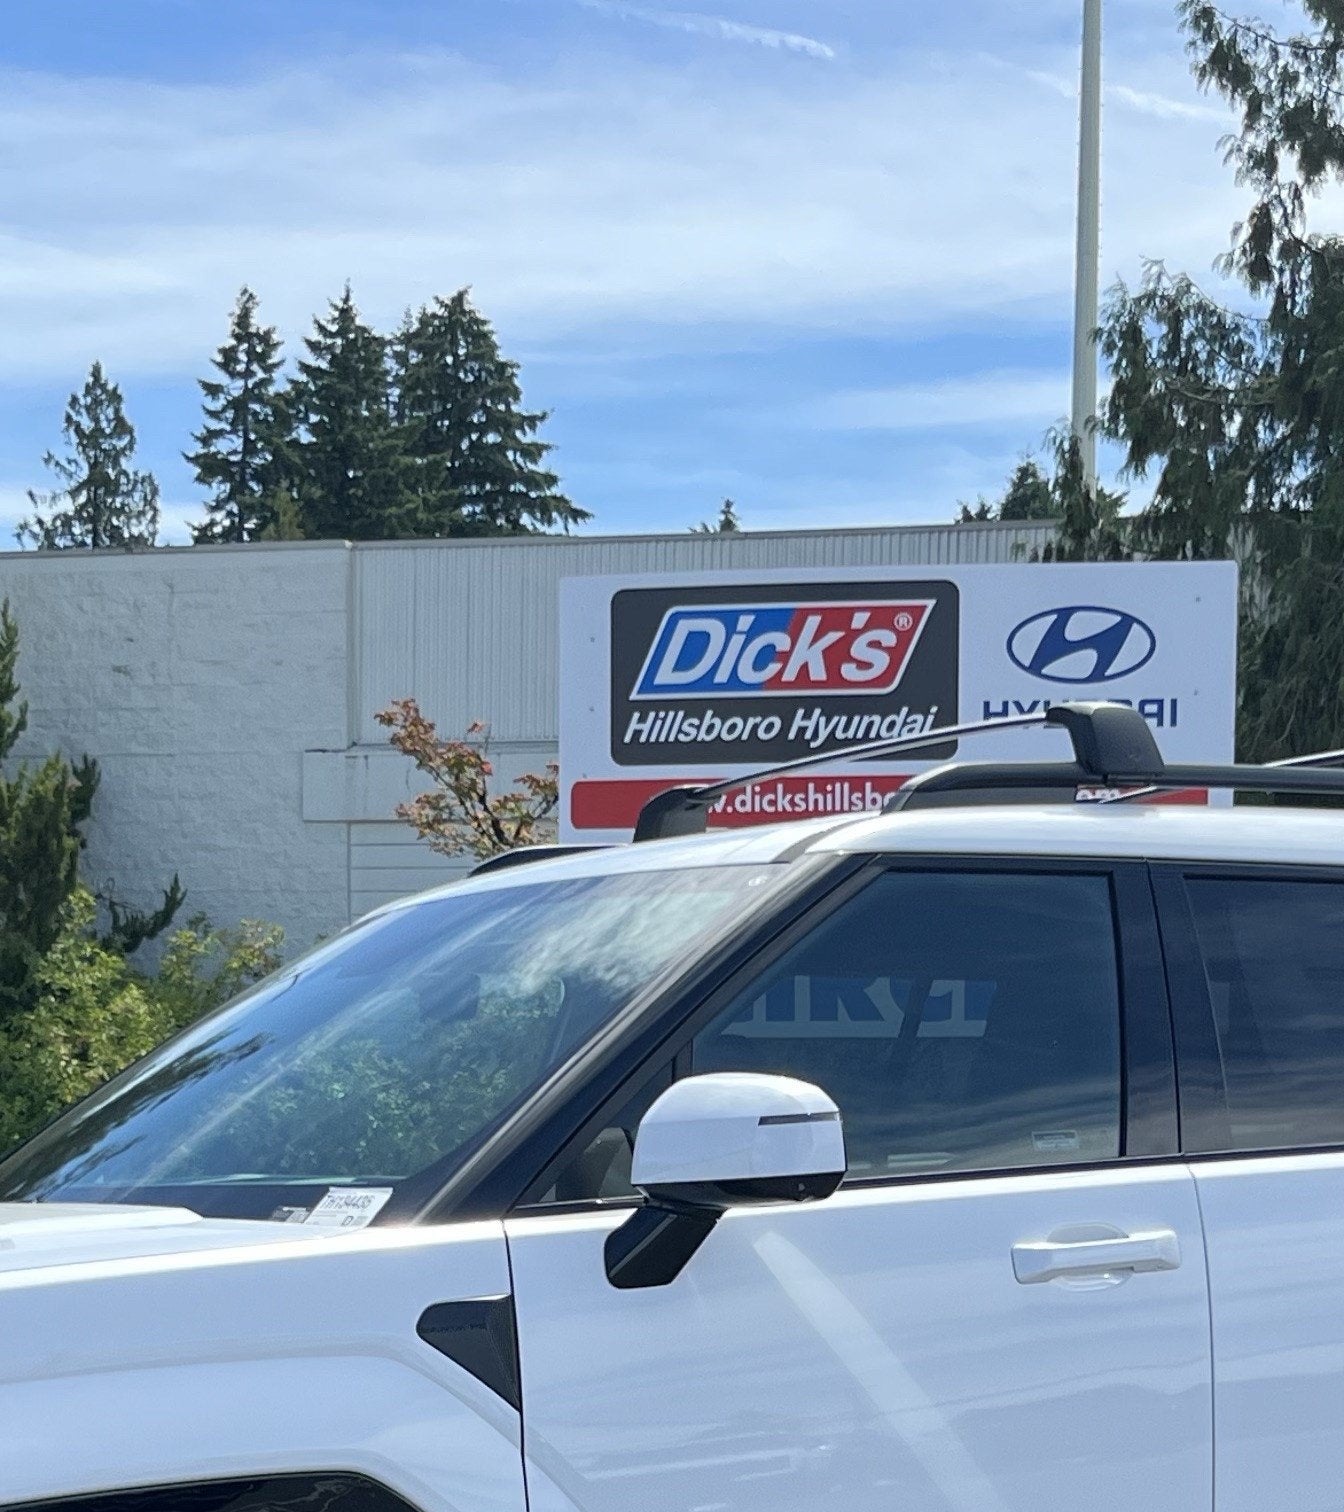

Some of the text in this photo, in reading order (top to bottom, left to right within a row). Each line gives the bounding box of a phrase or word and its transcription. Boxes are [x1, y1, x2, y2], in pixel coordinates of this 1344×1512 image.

[653, 612, 898, 685] Dick's
[623, 705, 939, 749] Hillsboro Hyundai
